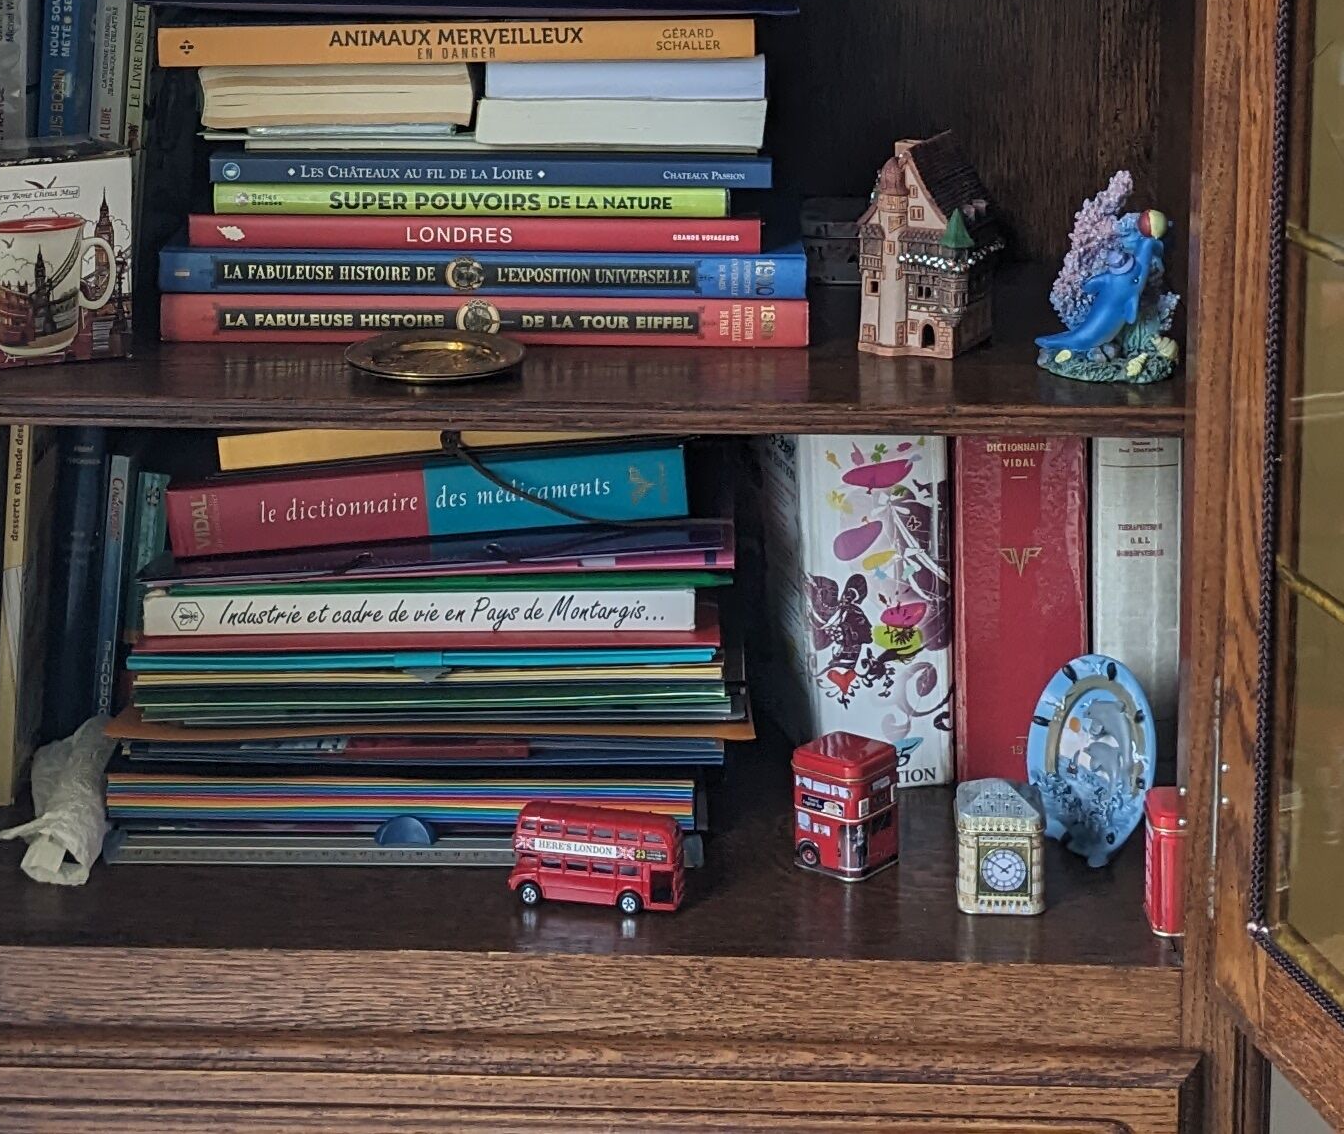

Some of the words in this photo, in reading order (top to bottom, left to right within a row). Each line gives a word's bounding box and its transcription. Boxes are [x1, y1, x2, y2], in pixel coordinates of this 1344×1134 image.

[49, 24, 61, 57] NOUS
[329, 29, 431, 47] ANIMAUX
[438, 27, 583, 46] MERVEILLEUX
[662, 28, 714, 40] GÉRARD
[417, 47, 433, 60] EN
[441, 46, 496, 60] DANGER
[656, 40, 721, 51] SCHALLER
[49, 115, 64, 138] UIS
[100, 106, 112, 131] LUNE
[301, 164, 324, 178] LES
[327, 165, 400, 179] CHÂTEAUX
[403, 168, 422, 179] AU
[426, 168, 446, 179] FIL
[450, 169, 467, 179] DE
[471, 169, 488, 180] LA
[492, 167, 533, 180] LOIRE
[12, 192, 32, 200] Bone
[329, 191, 408, 210] SUPER
[414, 192, 541, 211] POUVOIRS
[548, 196, 571, 209] DE
[575, 196, 599, 209] LA
[602, 197, 673, 210] NATURE
[406, 226, 513, 244] LONDRES
[223, 264, 242, 280] LA
[247, 264, 334, 280] FABULEUSE
[339, 265, 411, 281] HISTOIRE
[415, 266, 436, 281] DE
[497, 267, 591, 283] L'EXPOSITION
[594, 268, 691, 285] UNIVERSELLE
[224, 313, 248, 326] LA
[254, 313, 354, 327] FABULEUSE
[359, 314, 445, 328] HISTOIRE
[521, 314, 545, 328] DE
[551, 315, 575, 329] LA
[579, 315, 630, 329] TOUR
[635, 316, 694, 330] EIFFEL
[986, 442, 1052, 453] DICTIONNAIRE
[13, 447, 24, 480] bande
[1002, 458, 1036, 467] VIDAL
[14, 482, 23, 496] en
[435, 484, 467, 509] des
[260, 500, 276, 523] le
[285, 492, 419, 522] dictionnaire
[10, 498, 22, 542] desserts
[191, 494, 212, 550] VIDAL
[219, 599, 302, 626] Industrie
[306, 603, 330, 623] et
[331, 599, 383, 624] cadre
[387, 599, 409, 623] de
[413, 602, 440, 622] vie
[444, 609, 466, 623] en
[470, 596, 520, 631] Pays
[523, 597, 545, 620] de
[548, 595, 665, 629] Montargis...
[1010, 745, 1024, 755] 19
[897, 767, 937, 784] TION
[538, 840, 571, 851] HERE'S
[573, 842, 613, 855] LONDON
[635, 849, 646, 859] 23
